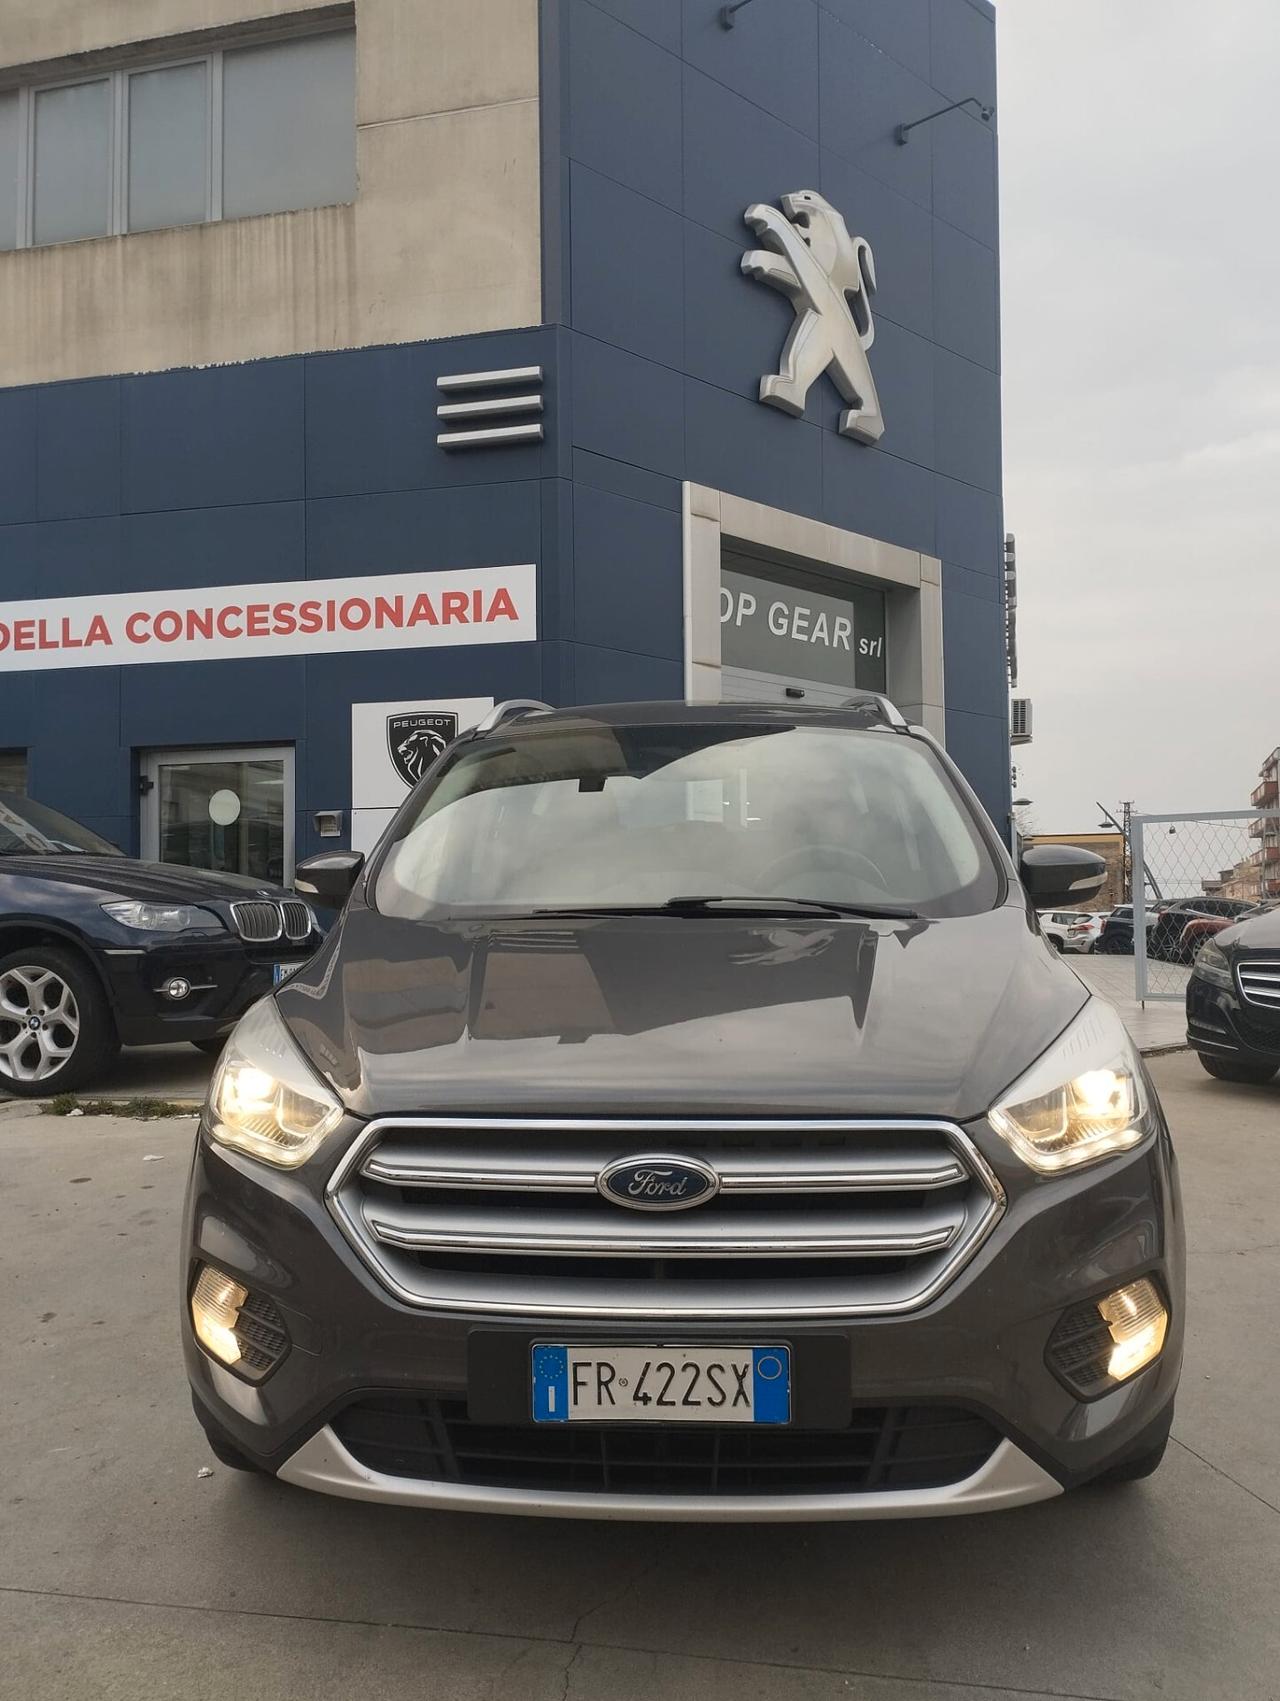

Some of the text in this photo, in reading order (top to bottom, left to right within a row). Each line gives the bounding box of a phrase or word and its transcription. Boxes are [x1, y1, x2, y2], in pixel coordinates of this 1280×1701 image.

[125, 587, 519, 644] CONCESSIONARIA
[768, 601, 851, 650] GEAR
[858, 636, 882, 658] srl
[393, 718, 451, 729] PEUGEOT
[627, 1169, 688, 1195] Ford
